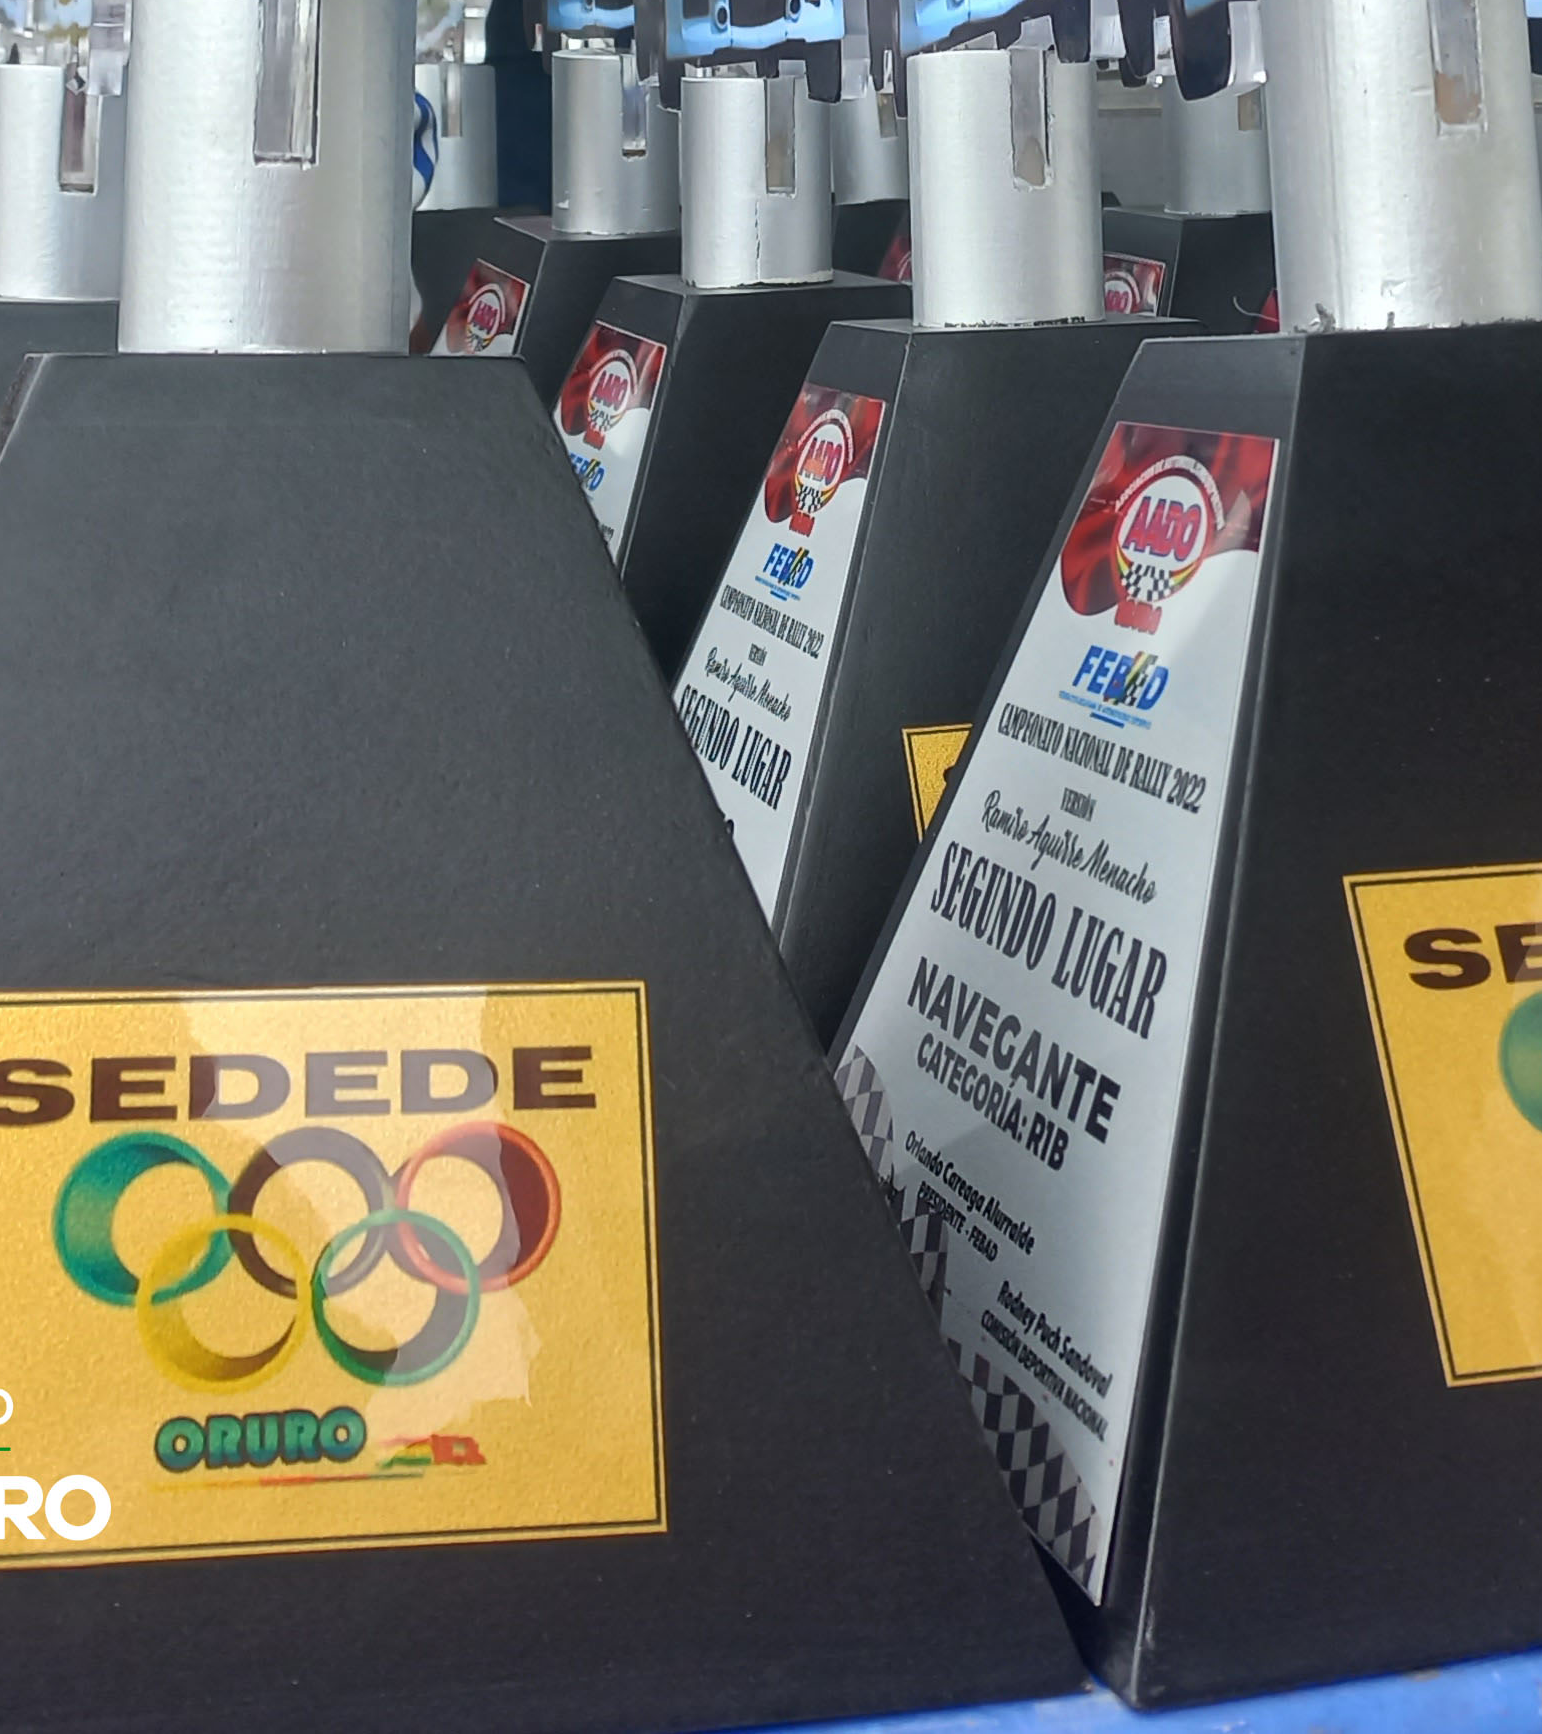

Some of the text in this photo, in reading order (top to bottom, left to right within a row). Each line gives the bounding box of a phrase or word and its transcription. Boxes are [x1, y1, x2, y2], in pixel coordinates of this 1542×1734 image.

[799, 437, 843, 486] AADO
[1122, 496, 1202, 562] AADO
[678, 683, 792, 811] SEGUNDO LUGAR
[997, 702, 1065, 756] CAMPEONATO
[1060, 727, 1117, 778] NACIONAL
[1112, 746, 1135, 784] DE
[1129, 753, 1173, 800] RALLY
[1166, 768, 1207, 815] 2022
[1079, 838, 1157, 904] Menacho
[930, 840, 1168, 1040] SEGUNDO LUGAR
[907, 956, 1122, 1144] NAVEGANTE
[917, 1032, 1028, 1143] CATEGORÍA:
[905, 1130, 1036, 1255] Orlando Careaga Alurralde
[918, 1181, 967, 1235] PRESIDENTE
[997, 1280, 1037, 1335] Rodney
[1058, 1336, 1114, 1399] Sandoval
[154, 1406, 368, 1471] ORURO
